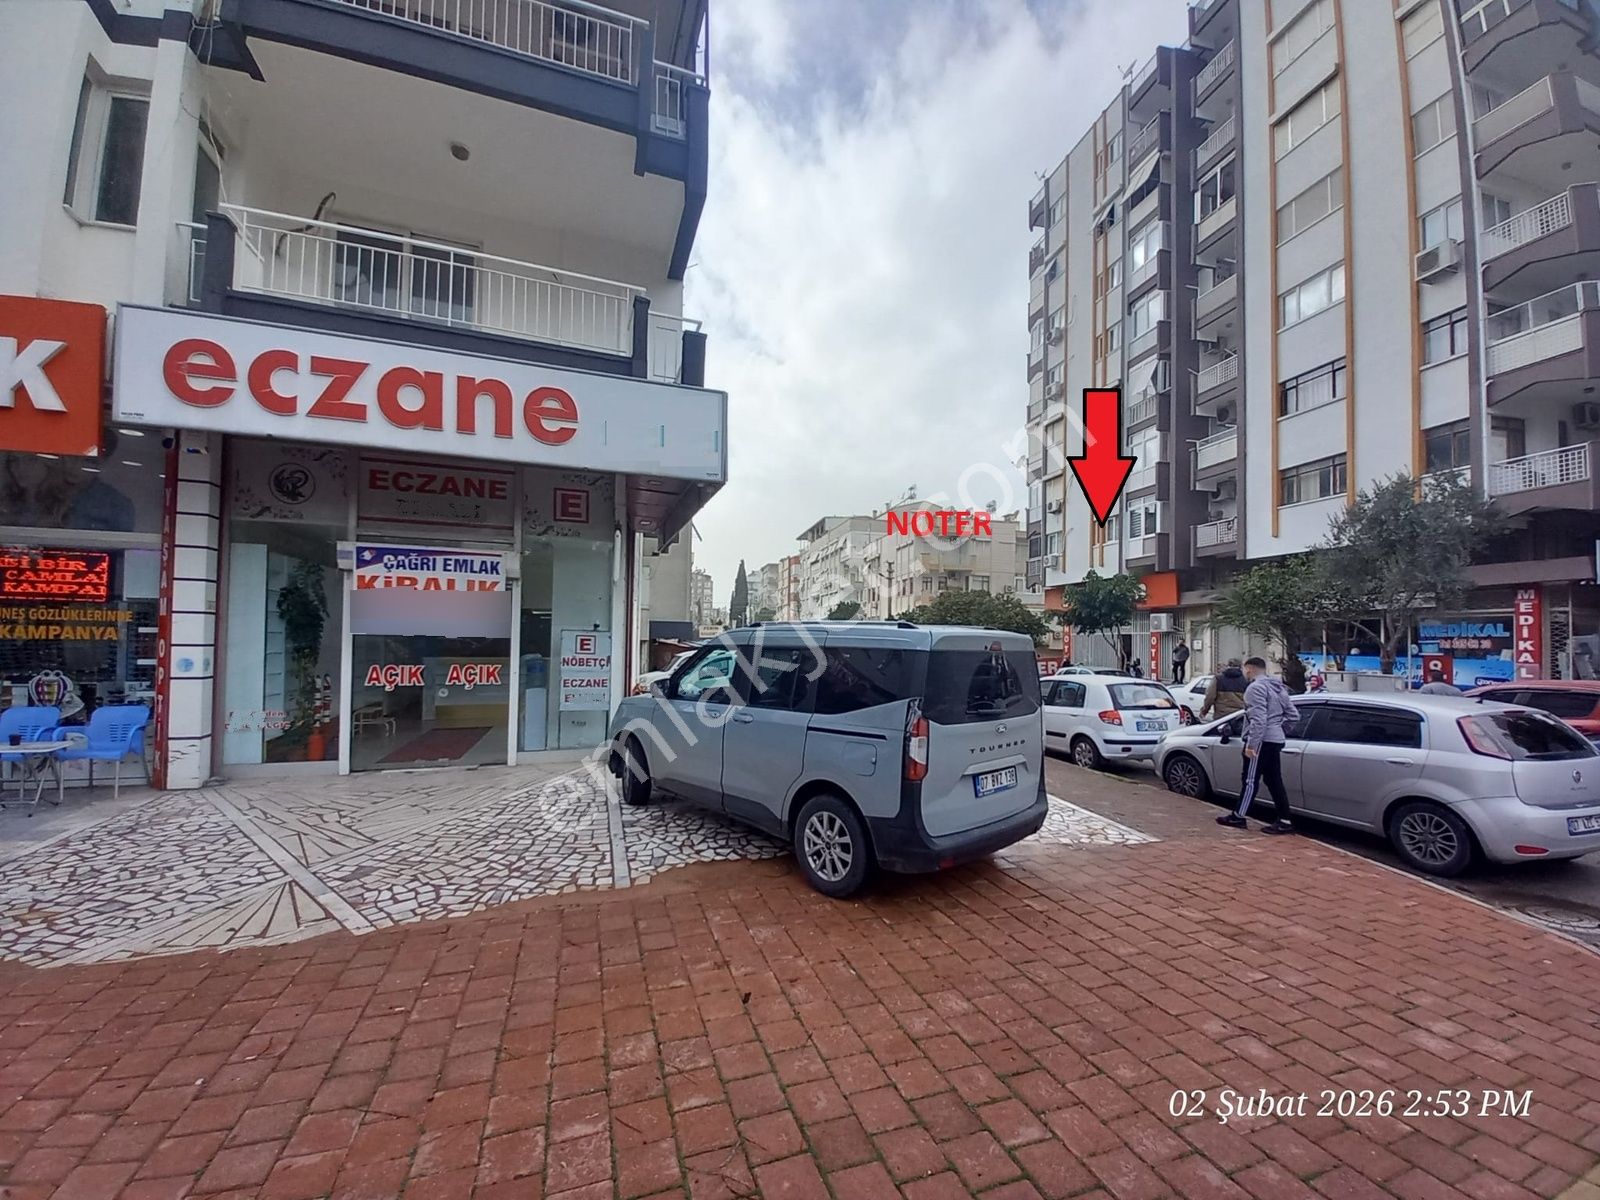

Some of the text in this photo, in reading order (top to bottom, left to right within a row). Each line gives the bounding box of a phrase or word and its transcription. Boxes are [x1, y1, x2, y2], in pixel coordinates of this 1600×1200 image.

[162, 337, 579, 446] eczane
[367, 468, 508, 501] ECZANE
[560, 492, 583, 519] E
[383, 552, 501, 576] ÇAĞRI EMLAK
[0, 624, 118, 641] KAMPANYA
[579, 638, 592, 652] E
[364, 663, 502, 691] AÇIK AÇIK
[563, 678, 608, 688] ECZANE
